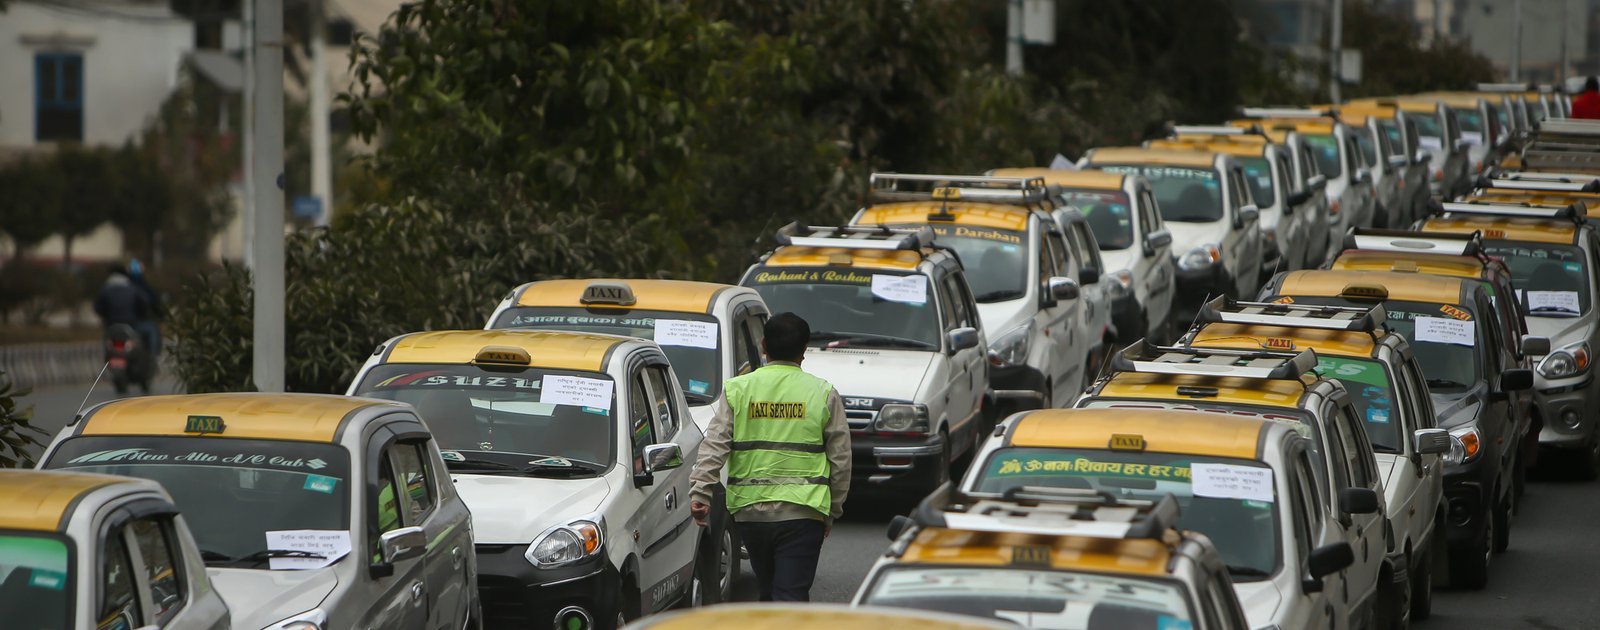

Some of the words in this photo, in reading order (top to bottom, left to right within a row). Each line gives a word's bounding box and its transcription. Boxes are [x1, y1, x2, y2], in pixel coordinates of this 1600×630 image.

[955, 226, 1020, 243] Darshan
[1484, 229, 1504, 238] TAXI
[755, 270, 809, 282] Roshani
[810, 271, 819, 280] &
[589, 286, 623, 299] TAXI
[1443, 305, 1470, 320] TAXI
[1268, 338, 1291, 348] TAXI
[488, 352, 517, 361] TAXI
[421, 375, 541, 389] SUZU
[751, 402, 768, 418] TAXI
[770, 403, 803, 418] SERVICE
[188, 417, 219, 432] TAXI
[1114, 437, 1140, 447] TAXI
[174, 452, 217, 462] Alto
[222, 453, 266, 464] A/C
[269, 456, 303, 467] Cab
[1074, 457, 1122, 473] शिवाय
[1123, 463, 1146, 475] हर
[1148, 465, 1173, 477] हर
